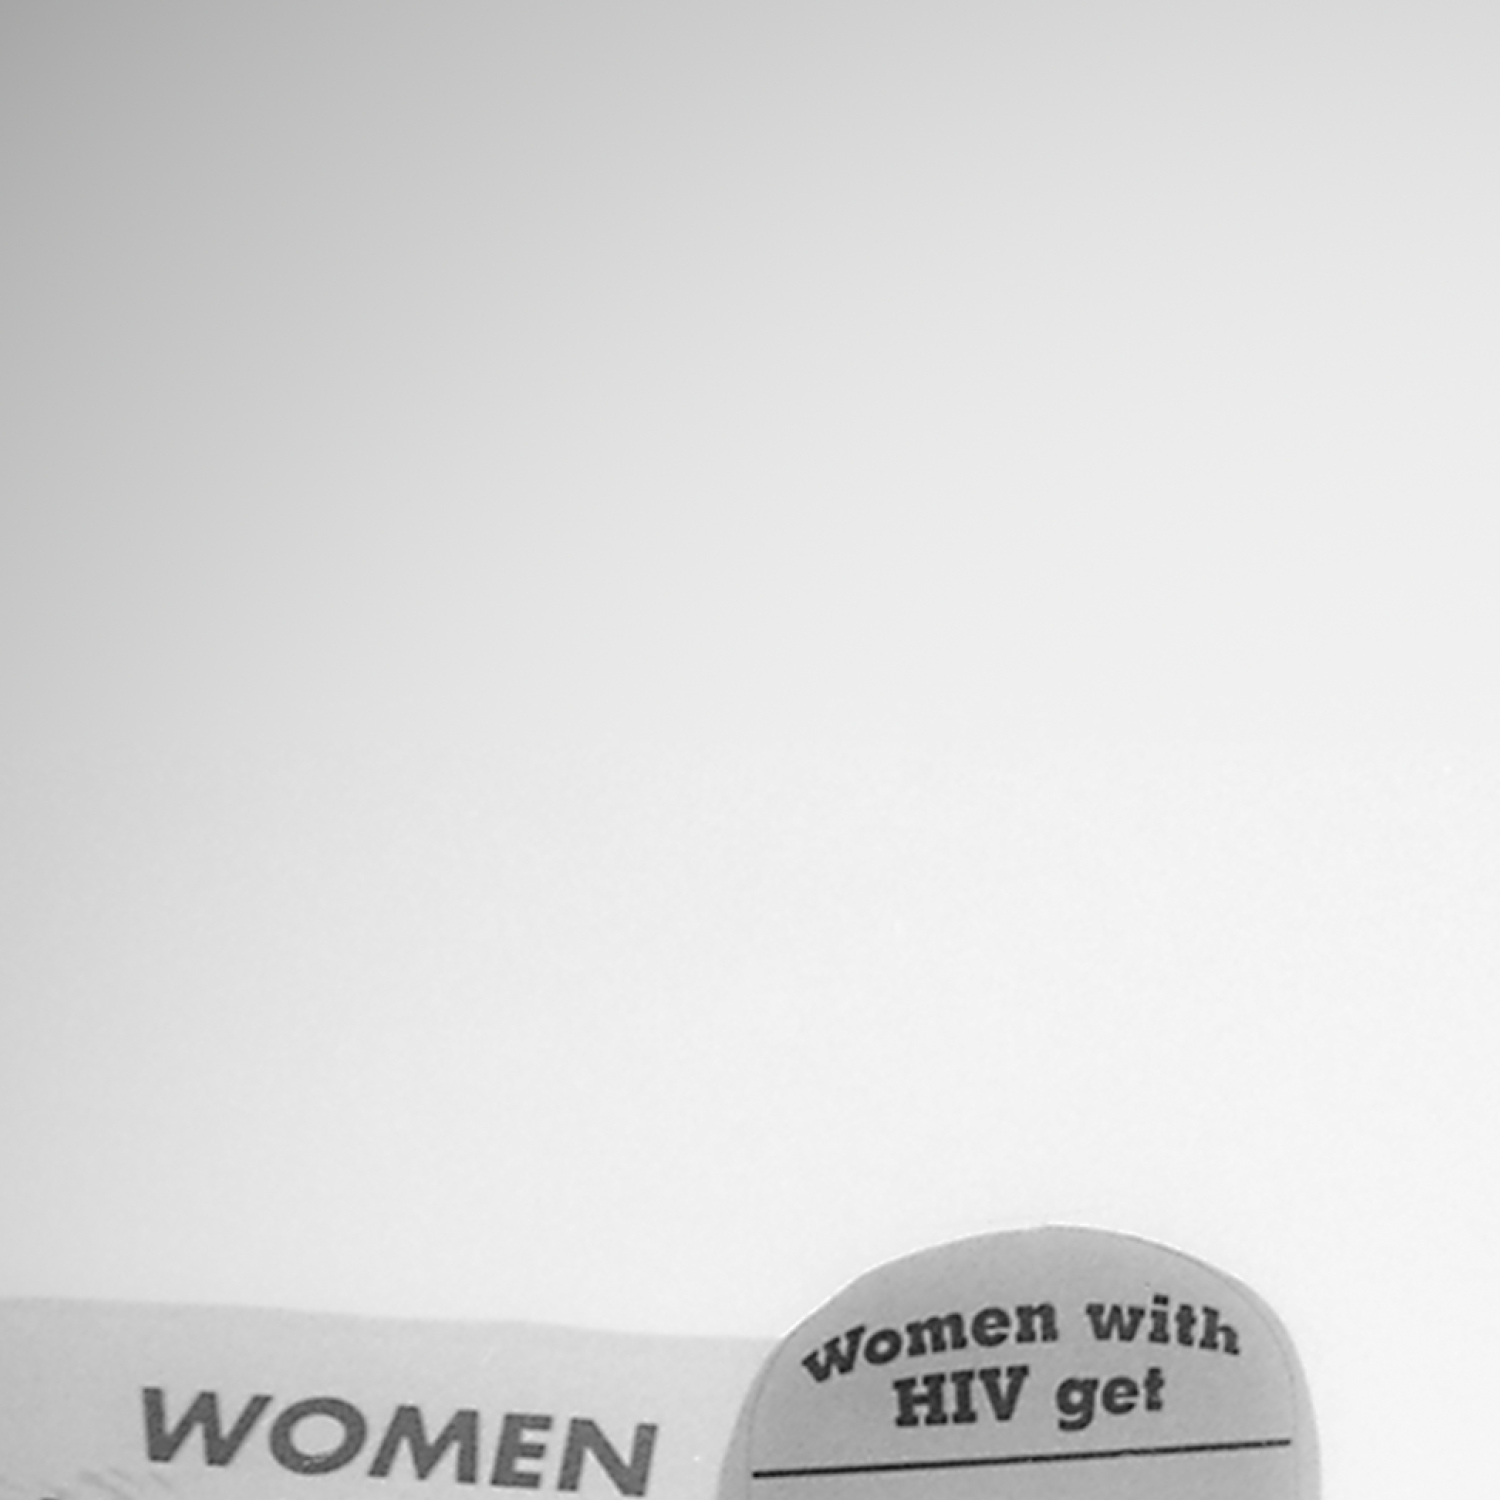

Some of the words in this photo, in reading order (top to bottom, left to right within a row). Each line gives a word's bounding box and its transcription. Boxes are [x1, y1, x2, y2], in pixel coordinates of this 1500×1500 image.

[801, 1299, 1059, 1384] Women
[1085, 1294, 1242, 1355] with
[141, 1386, 659, 1498] WOMEN
[893, 1364, 1030, 1428] HIV
[1055, 1366, 1166, 1432] get
